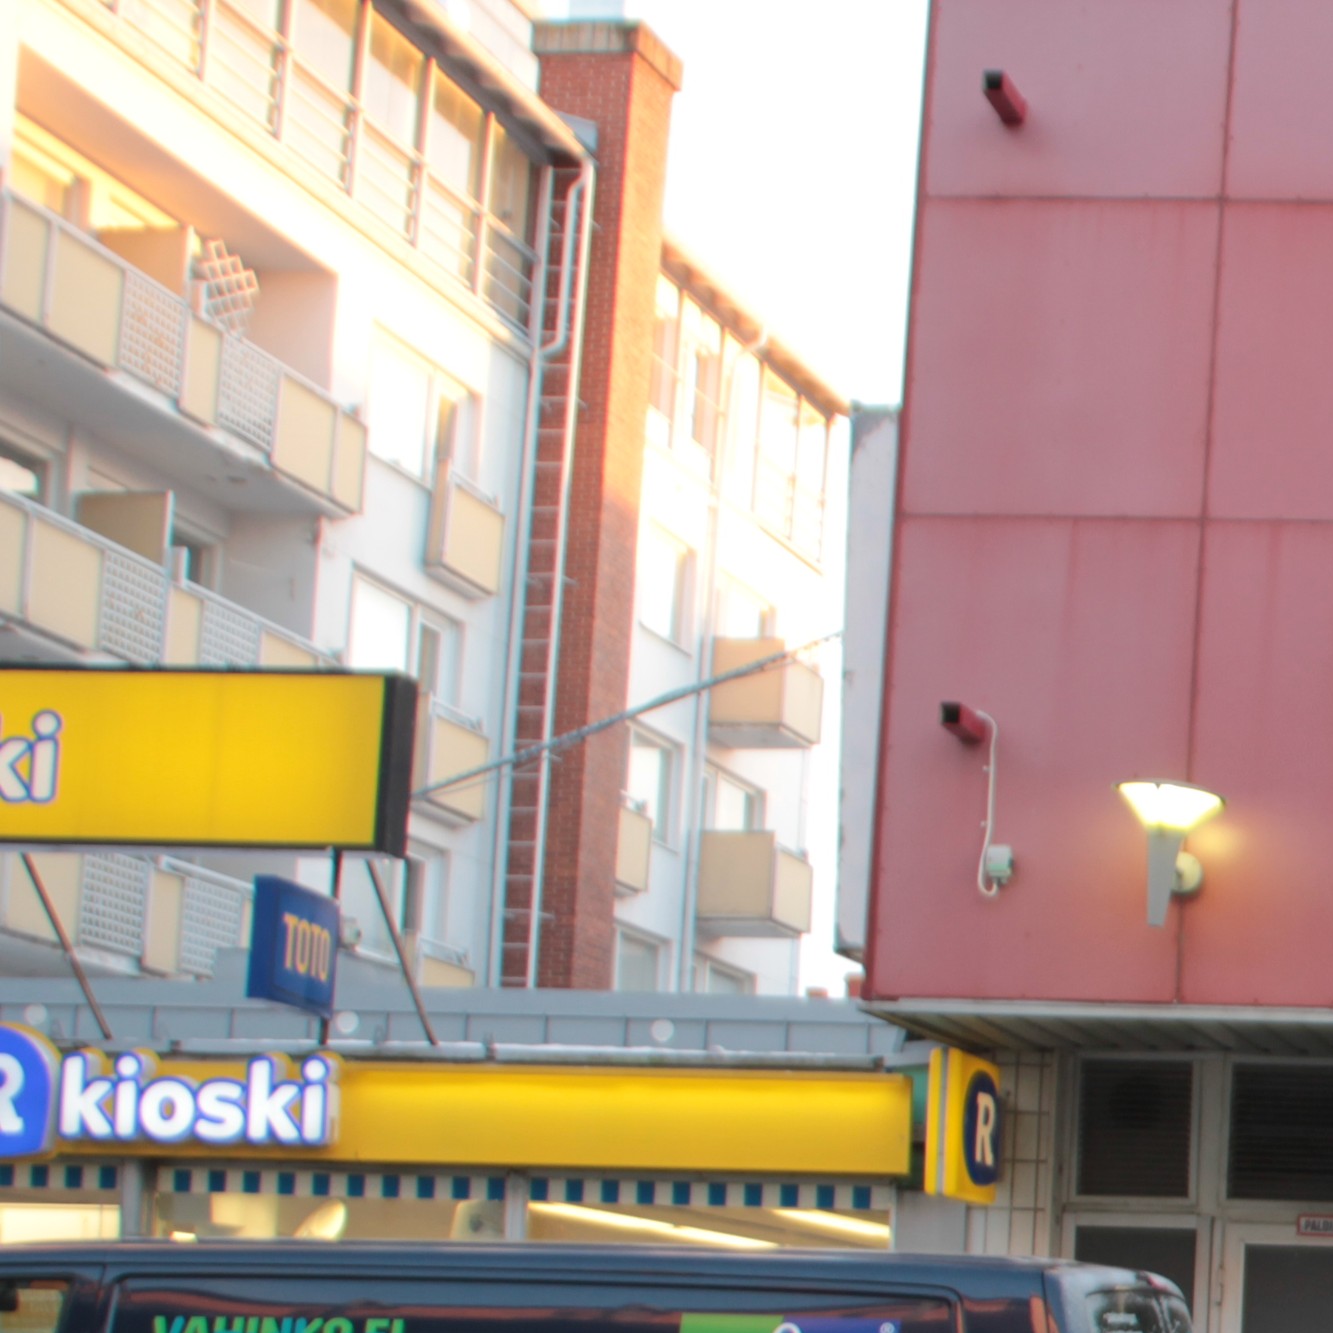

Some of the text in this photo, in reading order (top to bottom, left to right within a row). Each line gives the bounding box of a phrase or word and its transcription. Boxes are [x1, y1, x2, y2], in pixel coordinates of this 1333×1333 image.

[283, 912, 330, 982] TOTO
[59, 1050, 331, 1144] kioski
[975, 1092, 995, 1167] R
